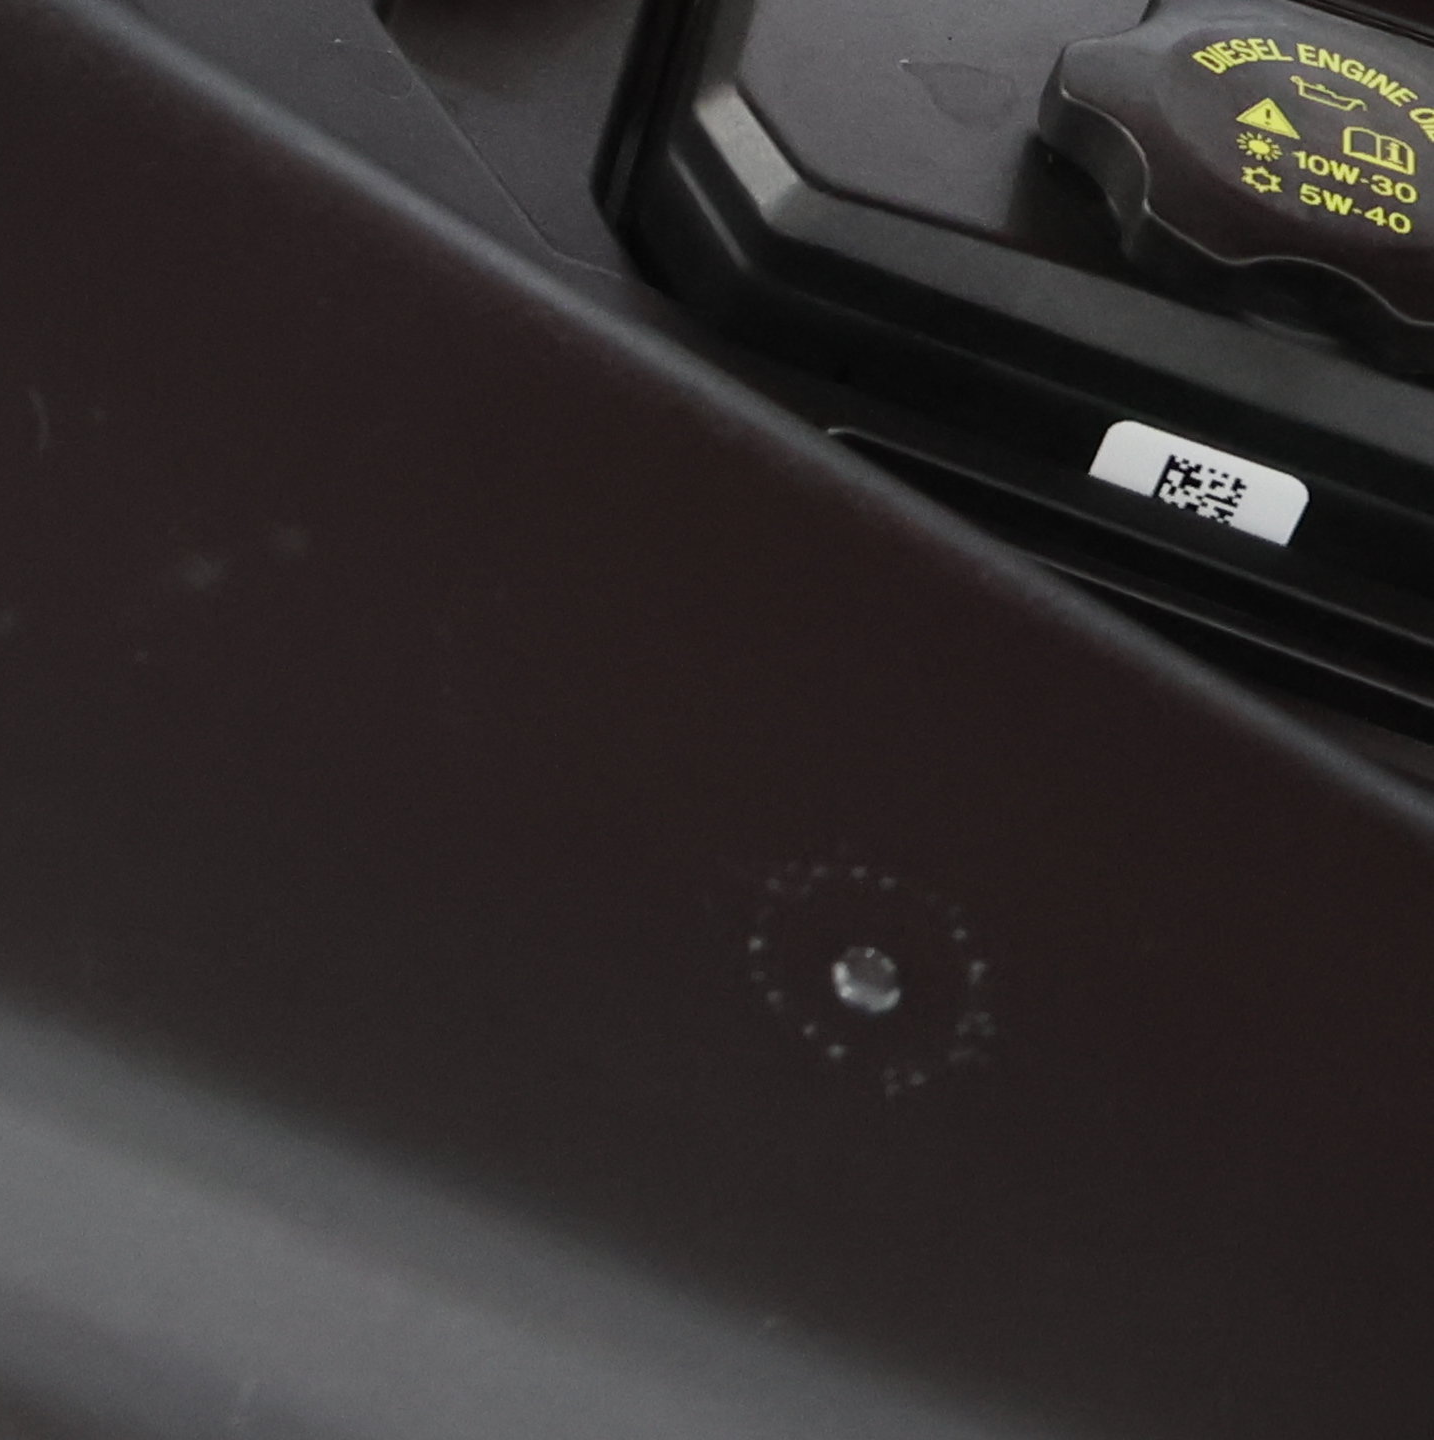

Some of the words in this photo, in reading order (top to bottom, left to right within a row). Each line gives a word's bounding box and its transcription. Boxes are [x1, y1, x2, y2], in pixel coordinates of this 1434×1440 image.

[1192, 38, 1295, 75] DIESEL
[1296, 43, 1419, 107] ENGINE
[1292, 150, 1418, 204] 10W-30
[1300, 183, 1412, 234] 5W-40
